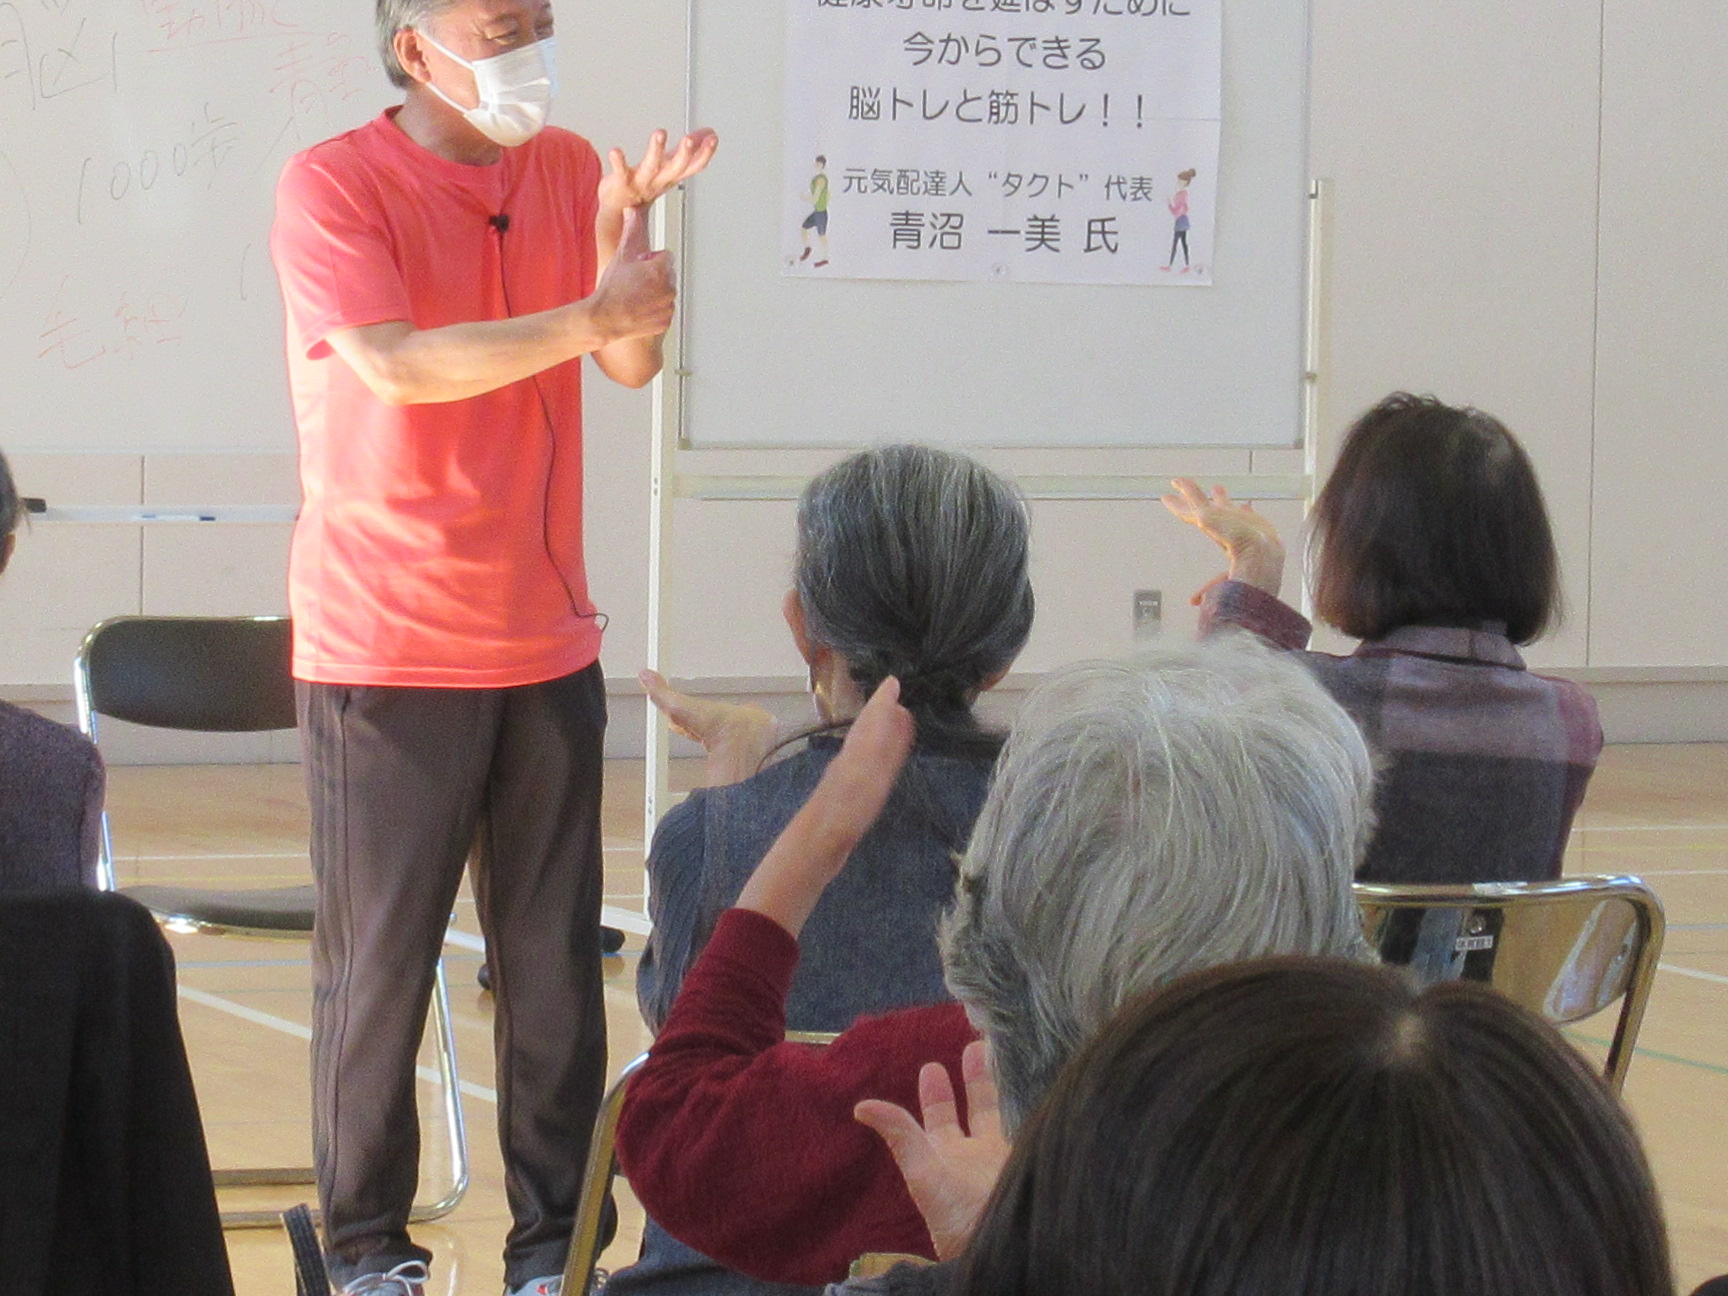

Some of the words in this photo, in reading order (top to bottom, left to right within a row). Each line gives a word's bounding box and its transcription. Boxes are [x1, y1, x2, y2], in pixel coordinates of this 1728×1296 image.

[903, 30, 1106, 71] 今からできる
[848, 85, 1145, 129] 脳トレと筋トレ！！
